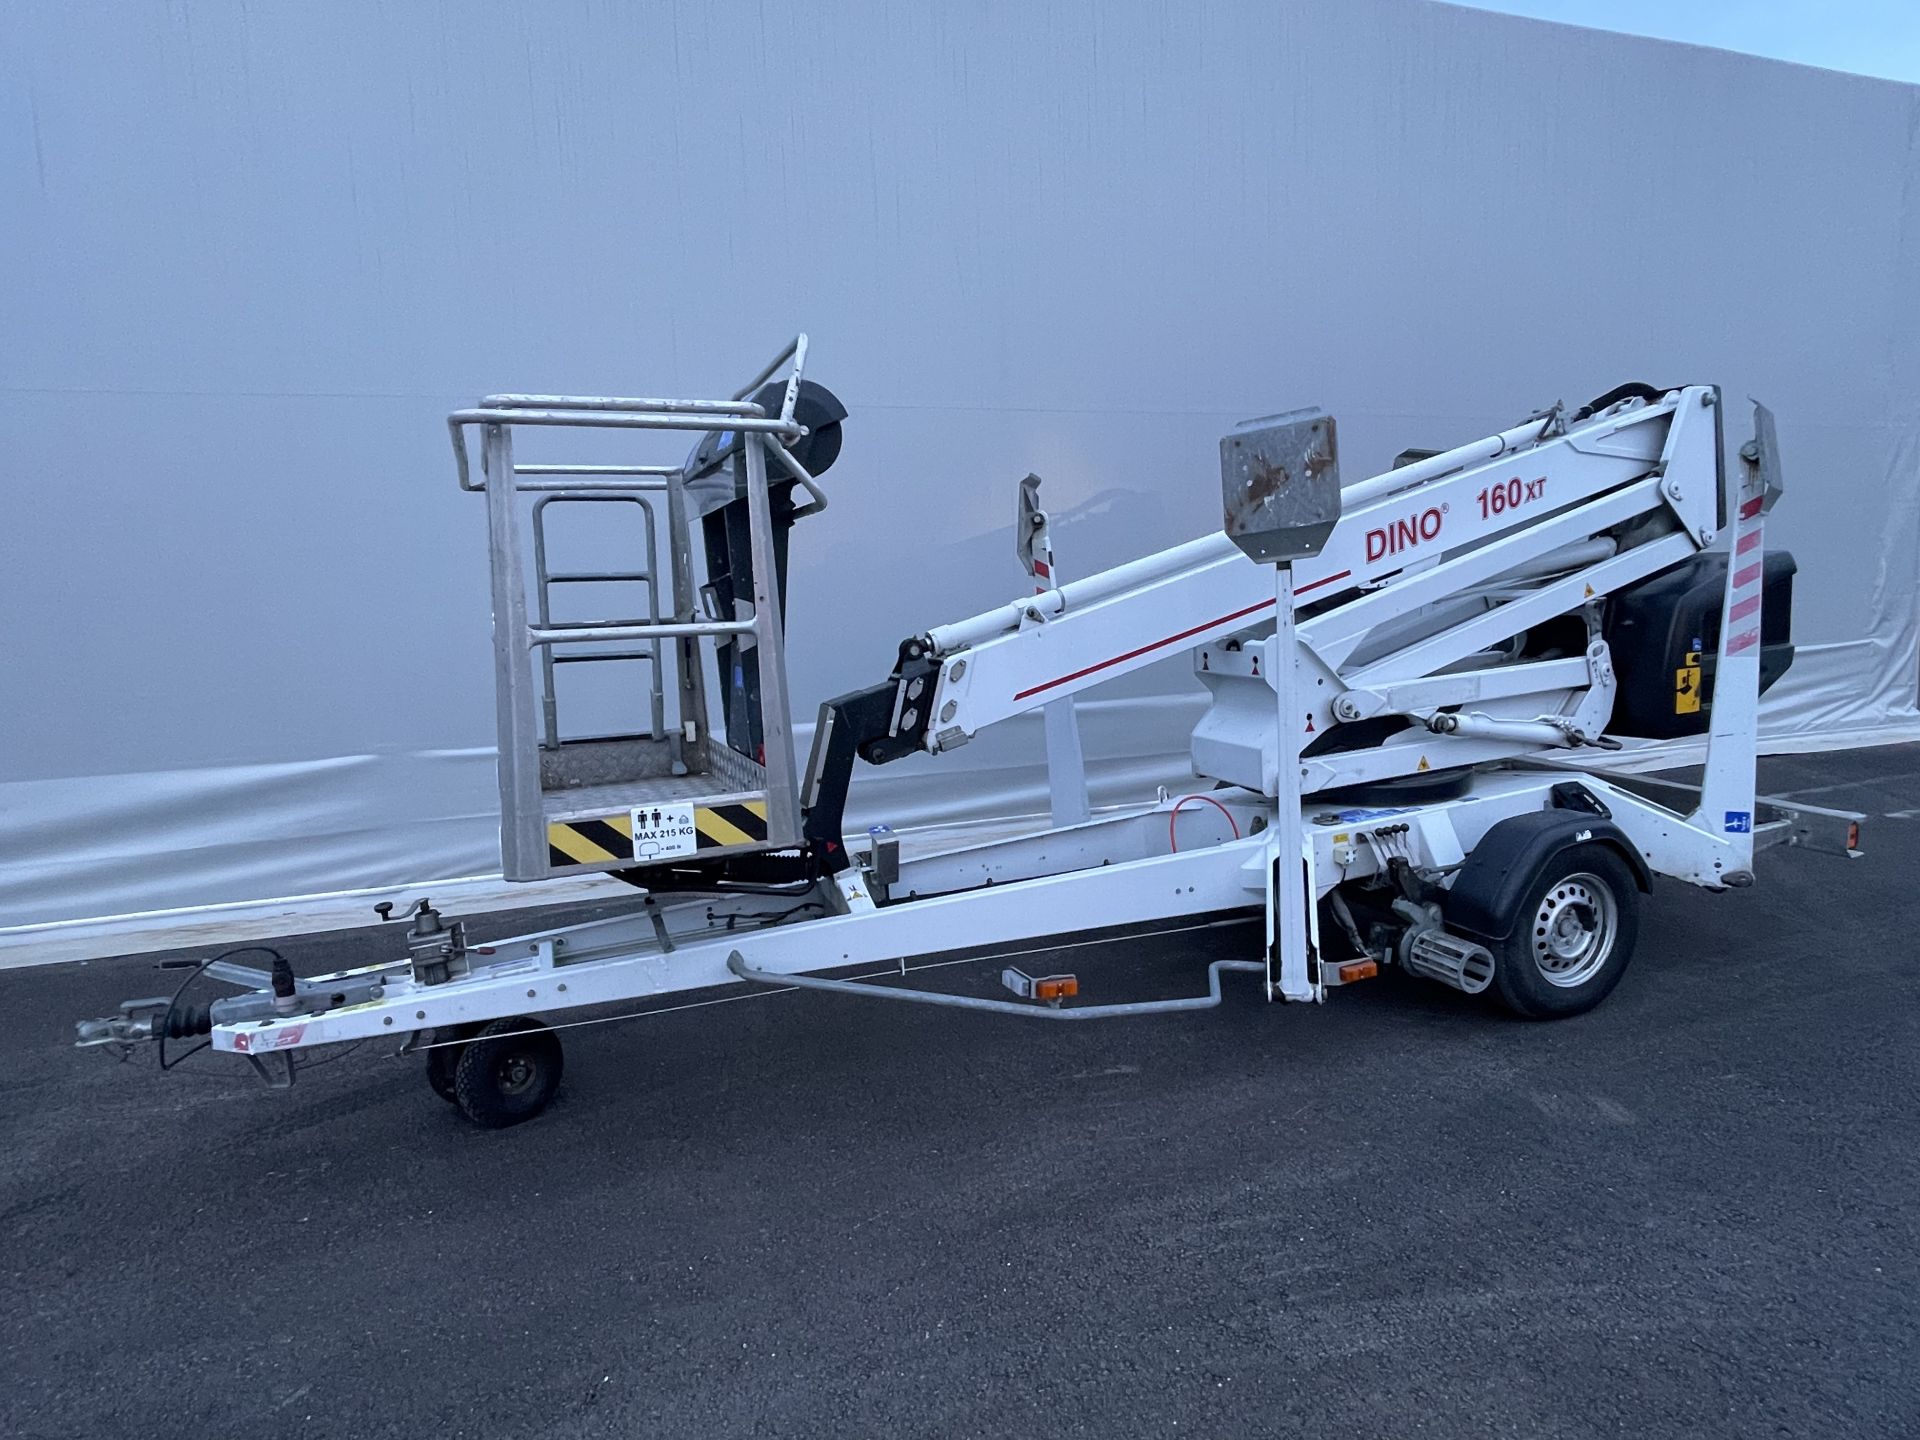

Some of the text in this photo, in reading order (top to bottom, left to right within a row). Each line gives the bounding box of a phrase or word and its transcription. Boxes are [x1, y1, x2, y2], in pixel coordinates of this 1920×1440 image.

[634, 827, 693, 841] MAX 215 KG
